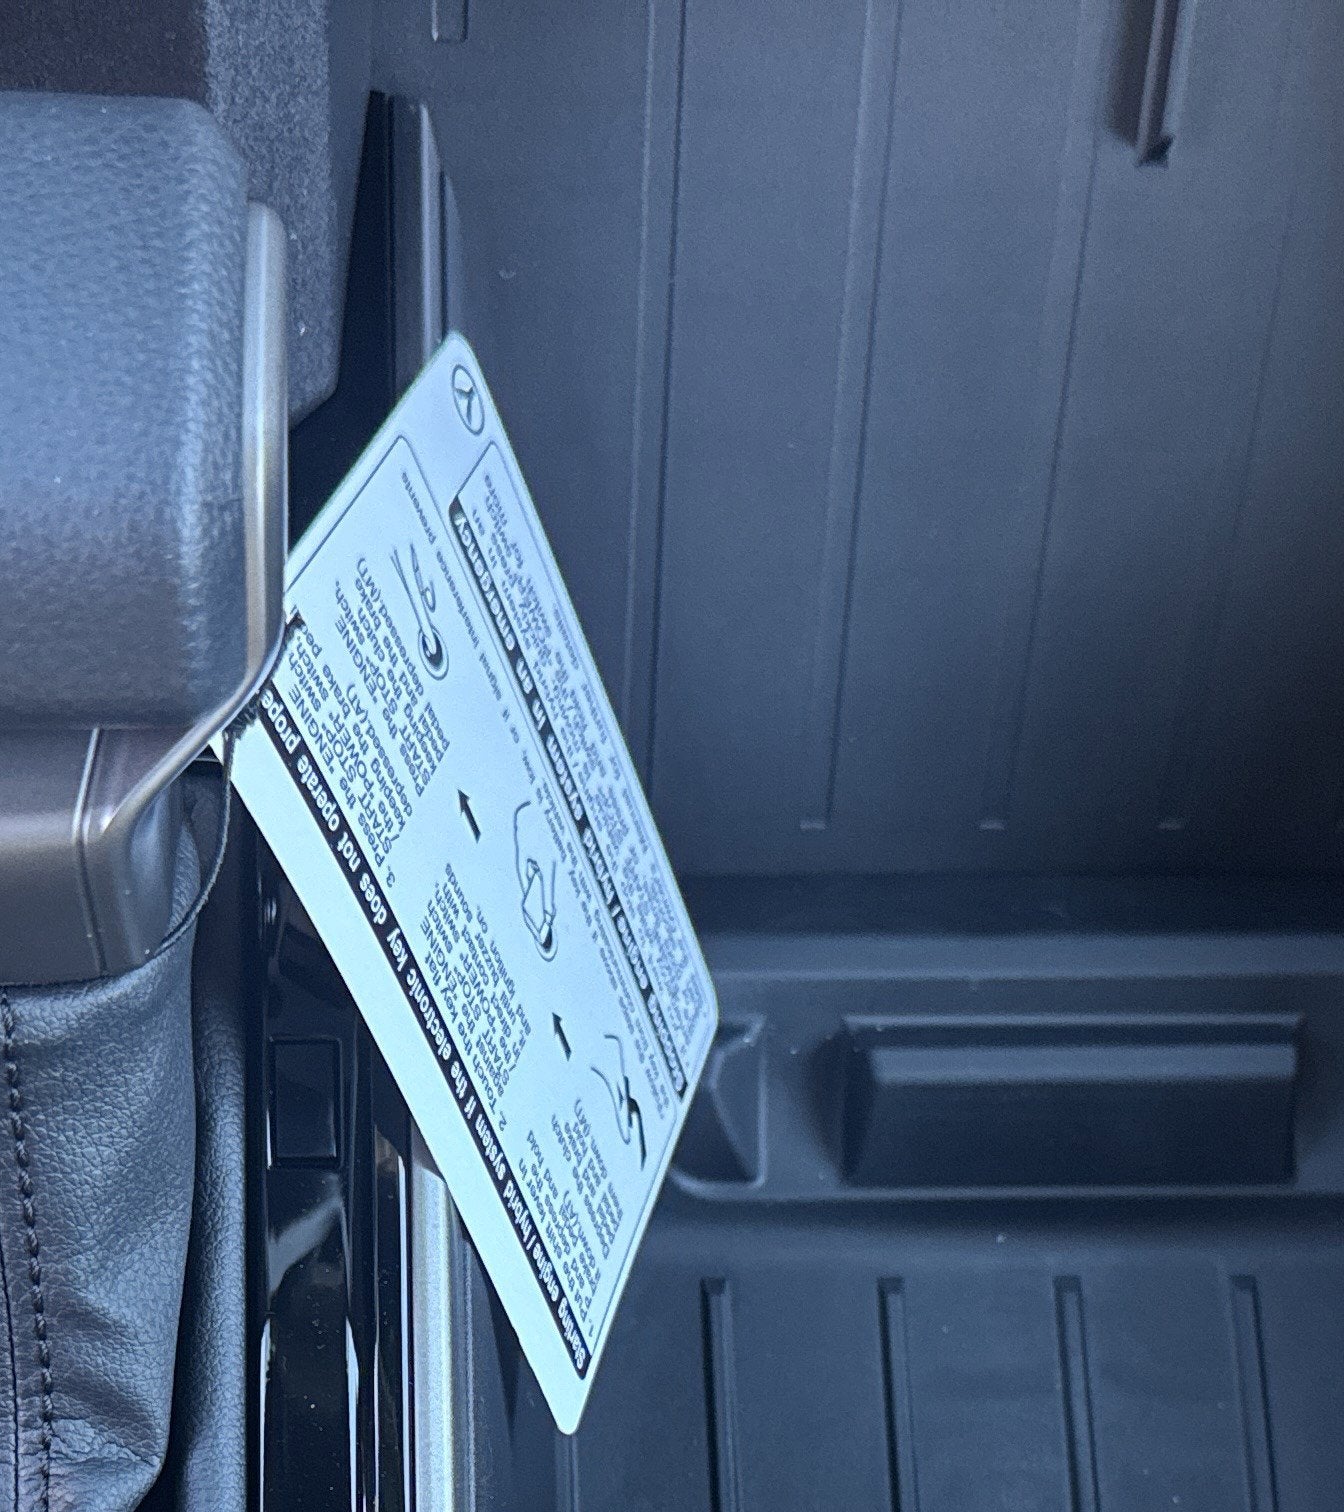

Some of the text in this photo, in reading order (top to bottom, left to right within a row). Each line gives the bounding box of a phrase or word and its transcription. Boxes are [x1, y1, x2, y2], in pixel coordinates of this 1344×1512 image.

[400, 470, 436, 546] prevents
[436, 549, 478, 649] interference
[454, 512, 516, 652] emergency
[287, 650, 322, 714] switch
[321, 663, 350, 720] brake
[354, 576, 444, 764] pedal and the brake
[357, 606, 437, 775] keeping the clutch
[478, 650, 502, 702] signal
[259, 686, 300, 756] prope
[351, 722, 368, 756] the
[380, 706, 398, 740] the
[424, 700, 450, 752] pedal
[398, 723, 430, 786] START
[398, 742, 424, 797] Press
[546, 732, 583, 822] system
[295, 752, 340, 834] operate
[338, 776, 356, 810] the
[369, 757, 406, 832] keeping
[356, 812, 384, 868] Press
[357, 790, 392, 855] START
[336, 832, 360, 874] not
[358, 872, 387, 928] does
[432, 882, 460, 944] switch,
[442, 882, 460, 920] with
[444, 862, 472, 924] sounds
[385, 924, 408, 972] key
[426, 898, 452, 955] switch
[424, 951, 442, 988] flat
[460, 924, 490, 987] contact
[474, 930, 500, 988] buzzer
[489, 938, 515, 1000] ignition
[404, 966, 452, 1063] electronic
[439, 984, 458, 1024] key
[460, 1002, 476, 1035] the
[490, 991, 512, 1038] direct
[500, 990, 516, 1026] until
[516, 1002, 532, 1036] and
[456, 1020, 472, 1056] the
[475, 1033, 505, 1098] against
[482, 1026, 510, 1086] START
[449, 1059, 468, 1100] the
[472, 1052, 498, 1114] Touch
[474, 1110, 507, 1182] system
[526, 1129, 544, 1168] hold
[530, 1162, 543, 1194] the
[542, 1167, 558, 1202] and
[571, 1164, 584, 1196] the
[562, 1260, 575, 1292] the
[570, 1258, 584, 1291] and
[556, 1295, 586, 1370] Starting
[573, 1288, 588, 1322] Put
